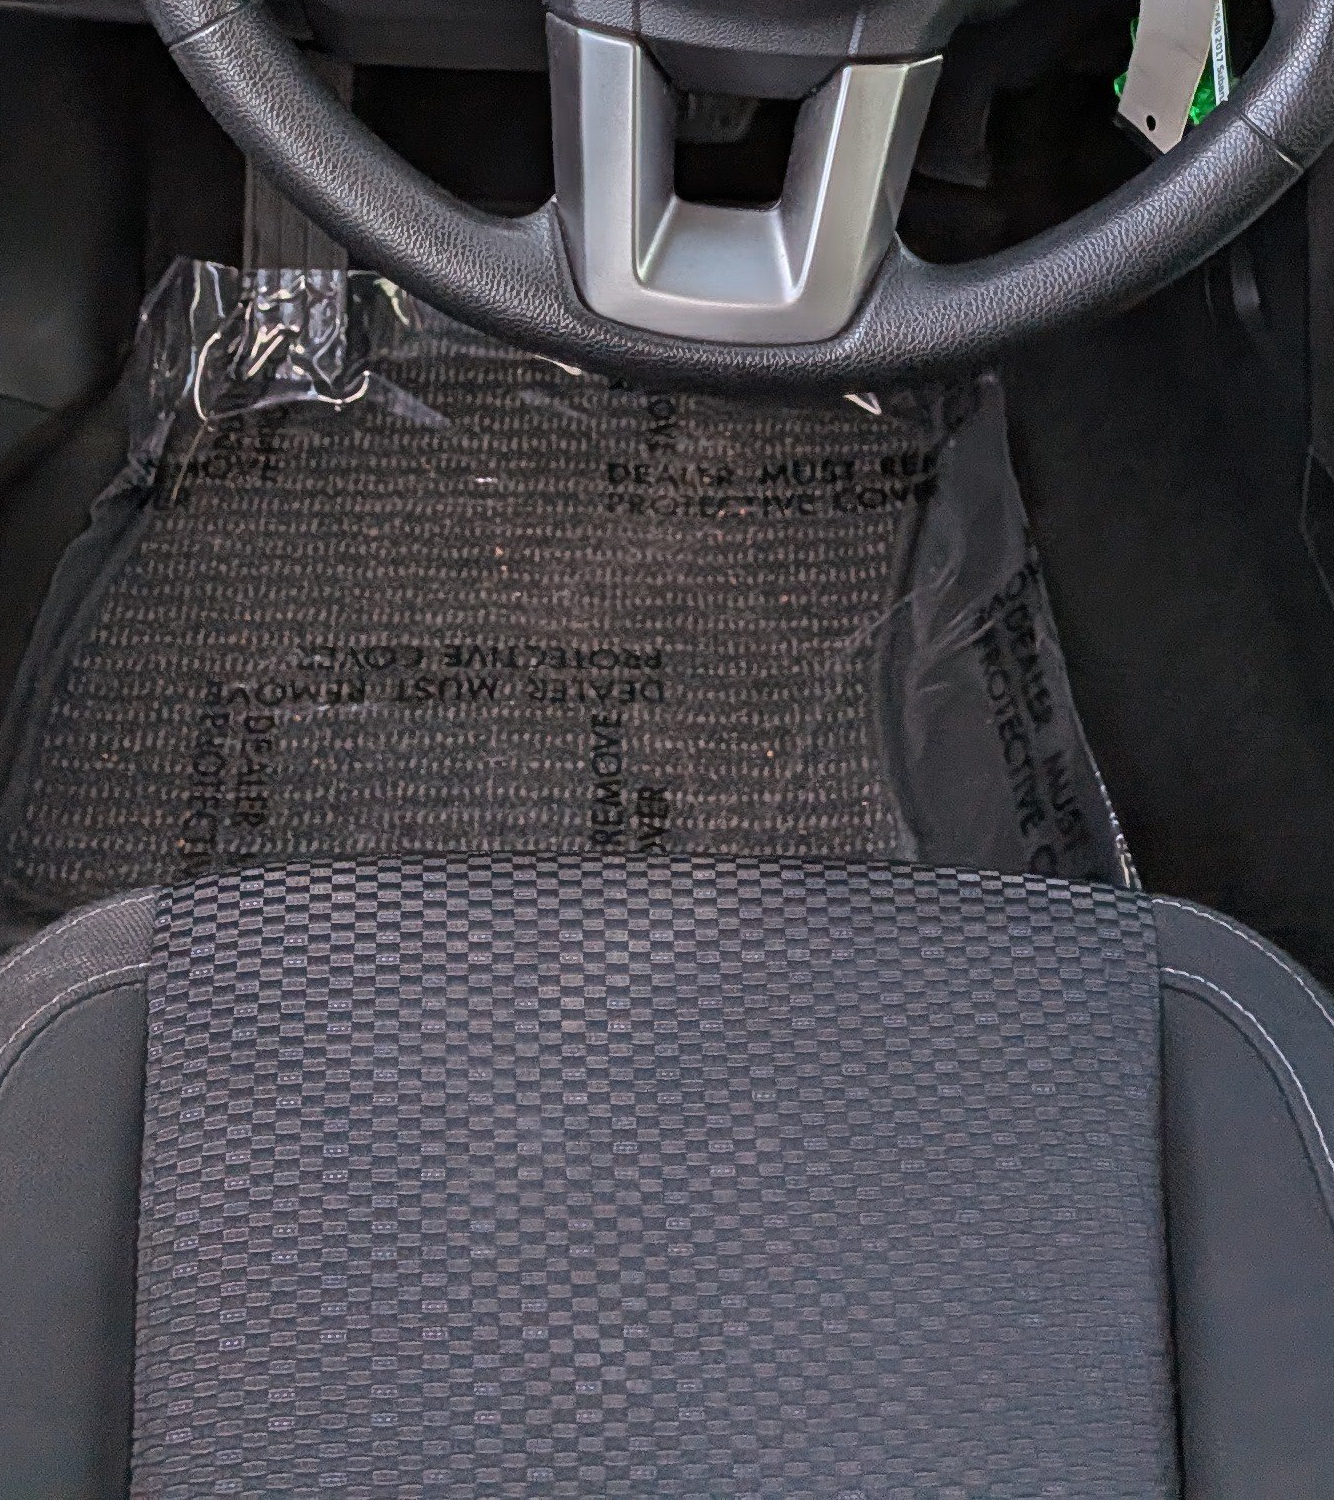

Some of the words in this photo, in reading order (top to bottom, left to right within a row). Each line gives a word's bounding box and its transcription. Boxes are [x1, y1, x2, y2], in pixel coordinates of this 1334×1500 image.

[1214, 37, 1224, 62] 2017
[607, 462, 734, 486] DEALER
[758, 458, 857, 486] MUST
[607, 491, 819, 518] PROTECTIVE
[294, 643, 425, 671] COVER
[441, 643, 663, 671] PROTECTIVE
[393, 674, 500, 705] MUST
[526, 679, 667, 705] DEALER
[588, 711, 624, 848] REMOVE
